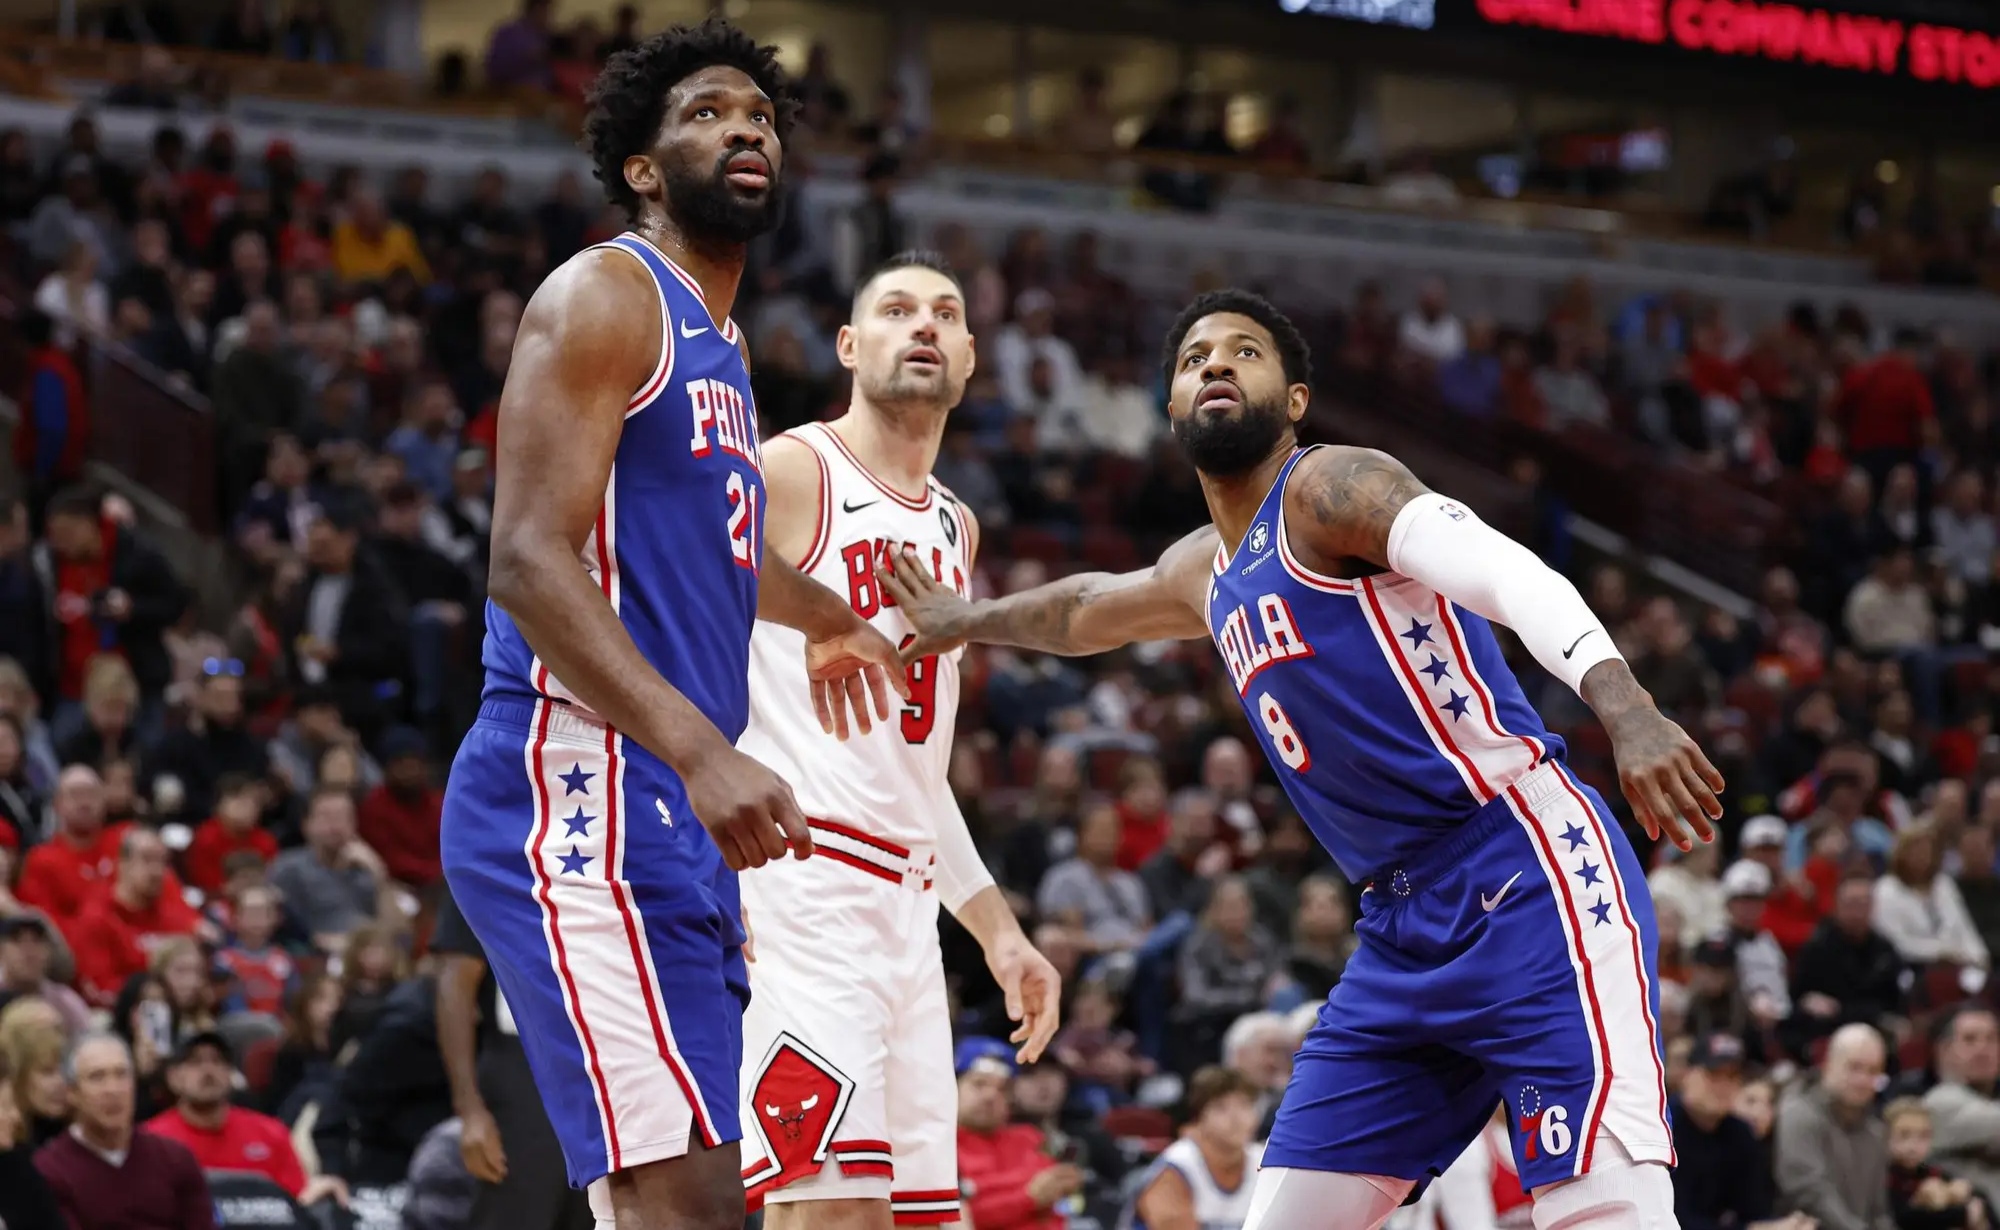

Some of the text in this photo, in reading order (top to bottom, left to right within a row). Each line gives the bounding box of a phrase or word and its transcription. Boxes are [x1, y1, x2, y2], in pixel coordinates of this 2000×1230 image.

[1670, 0, 1904, 74] COMPANY
[726, 470, 761, 578] 21
[1241, 547, 1275, 576] crypto.com
[1219, 592, 1316, 699] HILA
[1258, 690, 1313, 776] 8
[1519, 1104, 1572, 1160] 76
